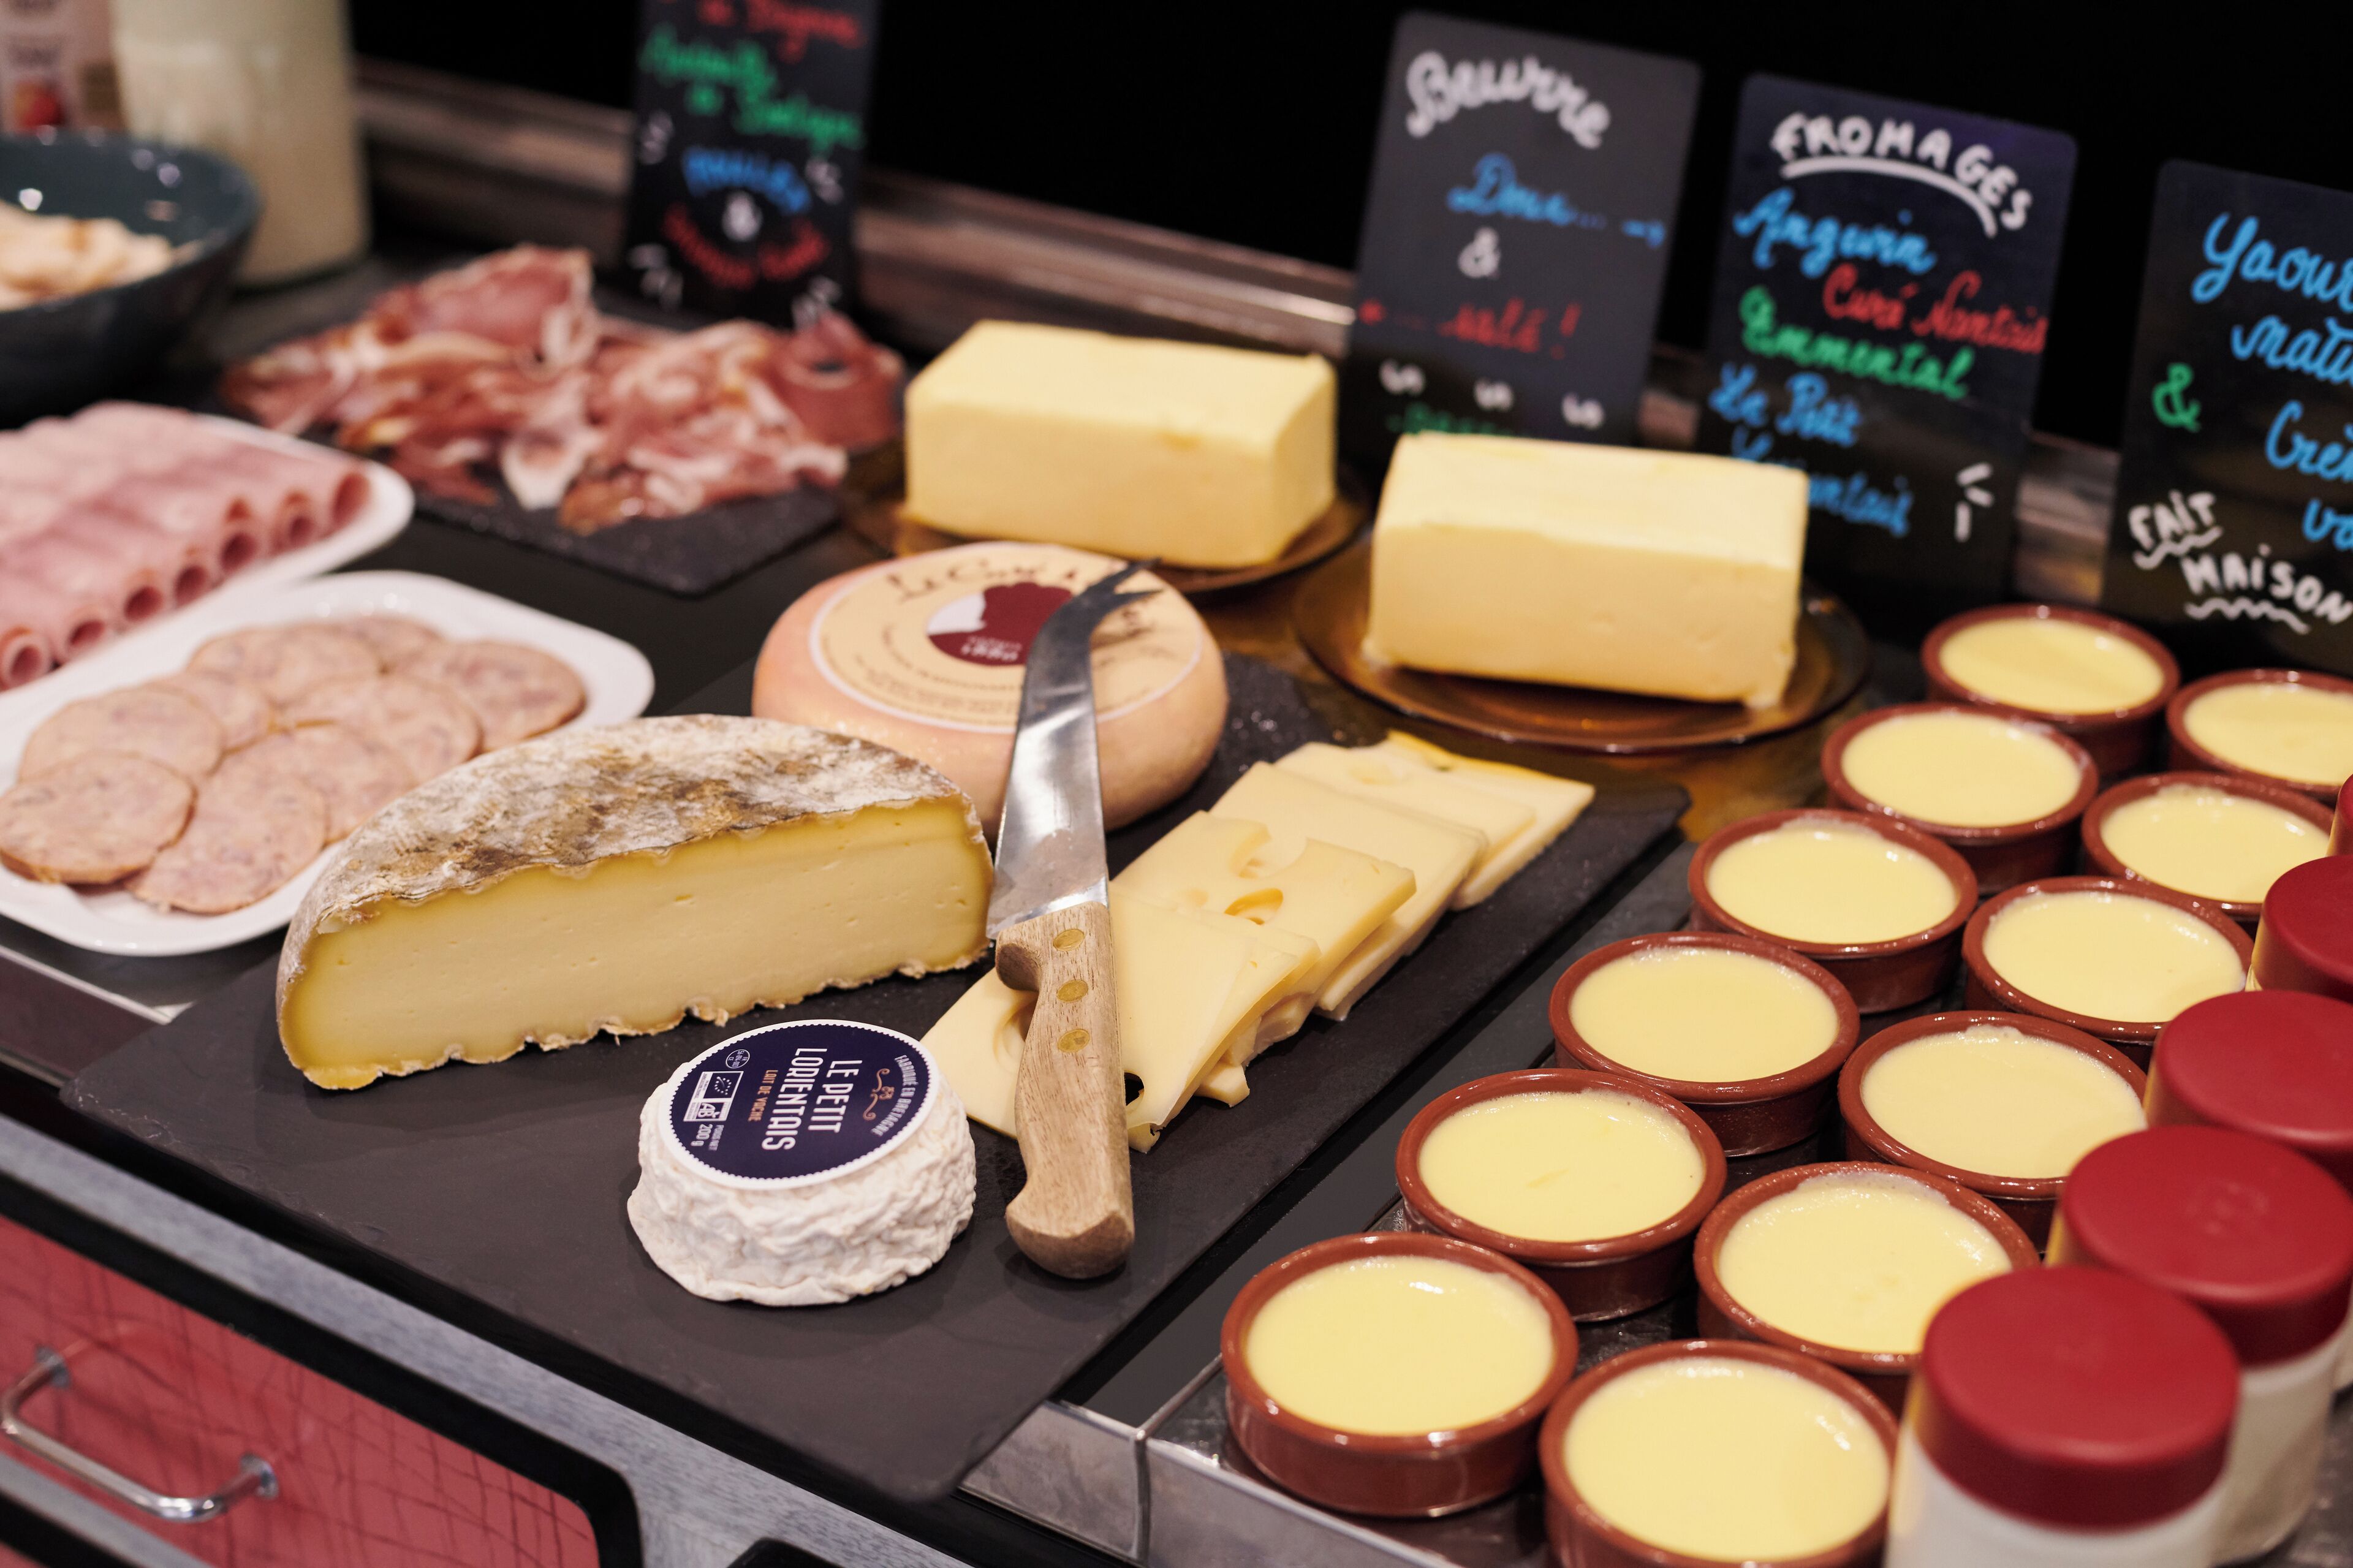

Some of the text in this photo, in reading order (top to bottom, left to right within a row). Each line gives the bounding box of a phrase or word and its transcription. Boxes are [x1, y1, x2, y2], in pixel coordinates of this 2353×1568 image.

[1406, 50, 1610, 149] Beurre
[1771, 112, 2033, 230] FROMAGES
[1739, 284, 1975, 400] Emmental
[2151, 362, 2201, 432] &
[696, 1124, 713, 1140] 200
[697, 1103, 716, 1118] AB
[748, 1070, 778, 1122] LAIT DE VACHE
[762, 1048, 827, 1150] LORIENTAIS
[808, 1060, 863, 1133] LE PETIT
[871, 1055, 919, 1137] FABRIQUÉ EN BRETAGNE
